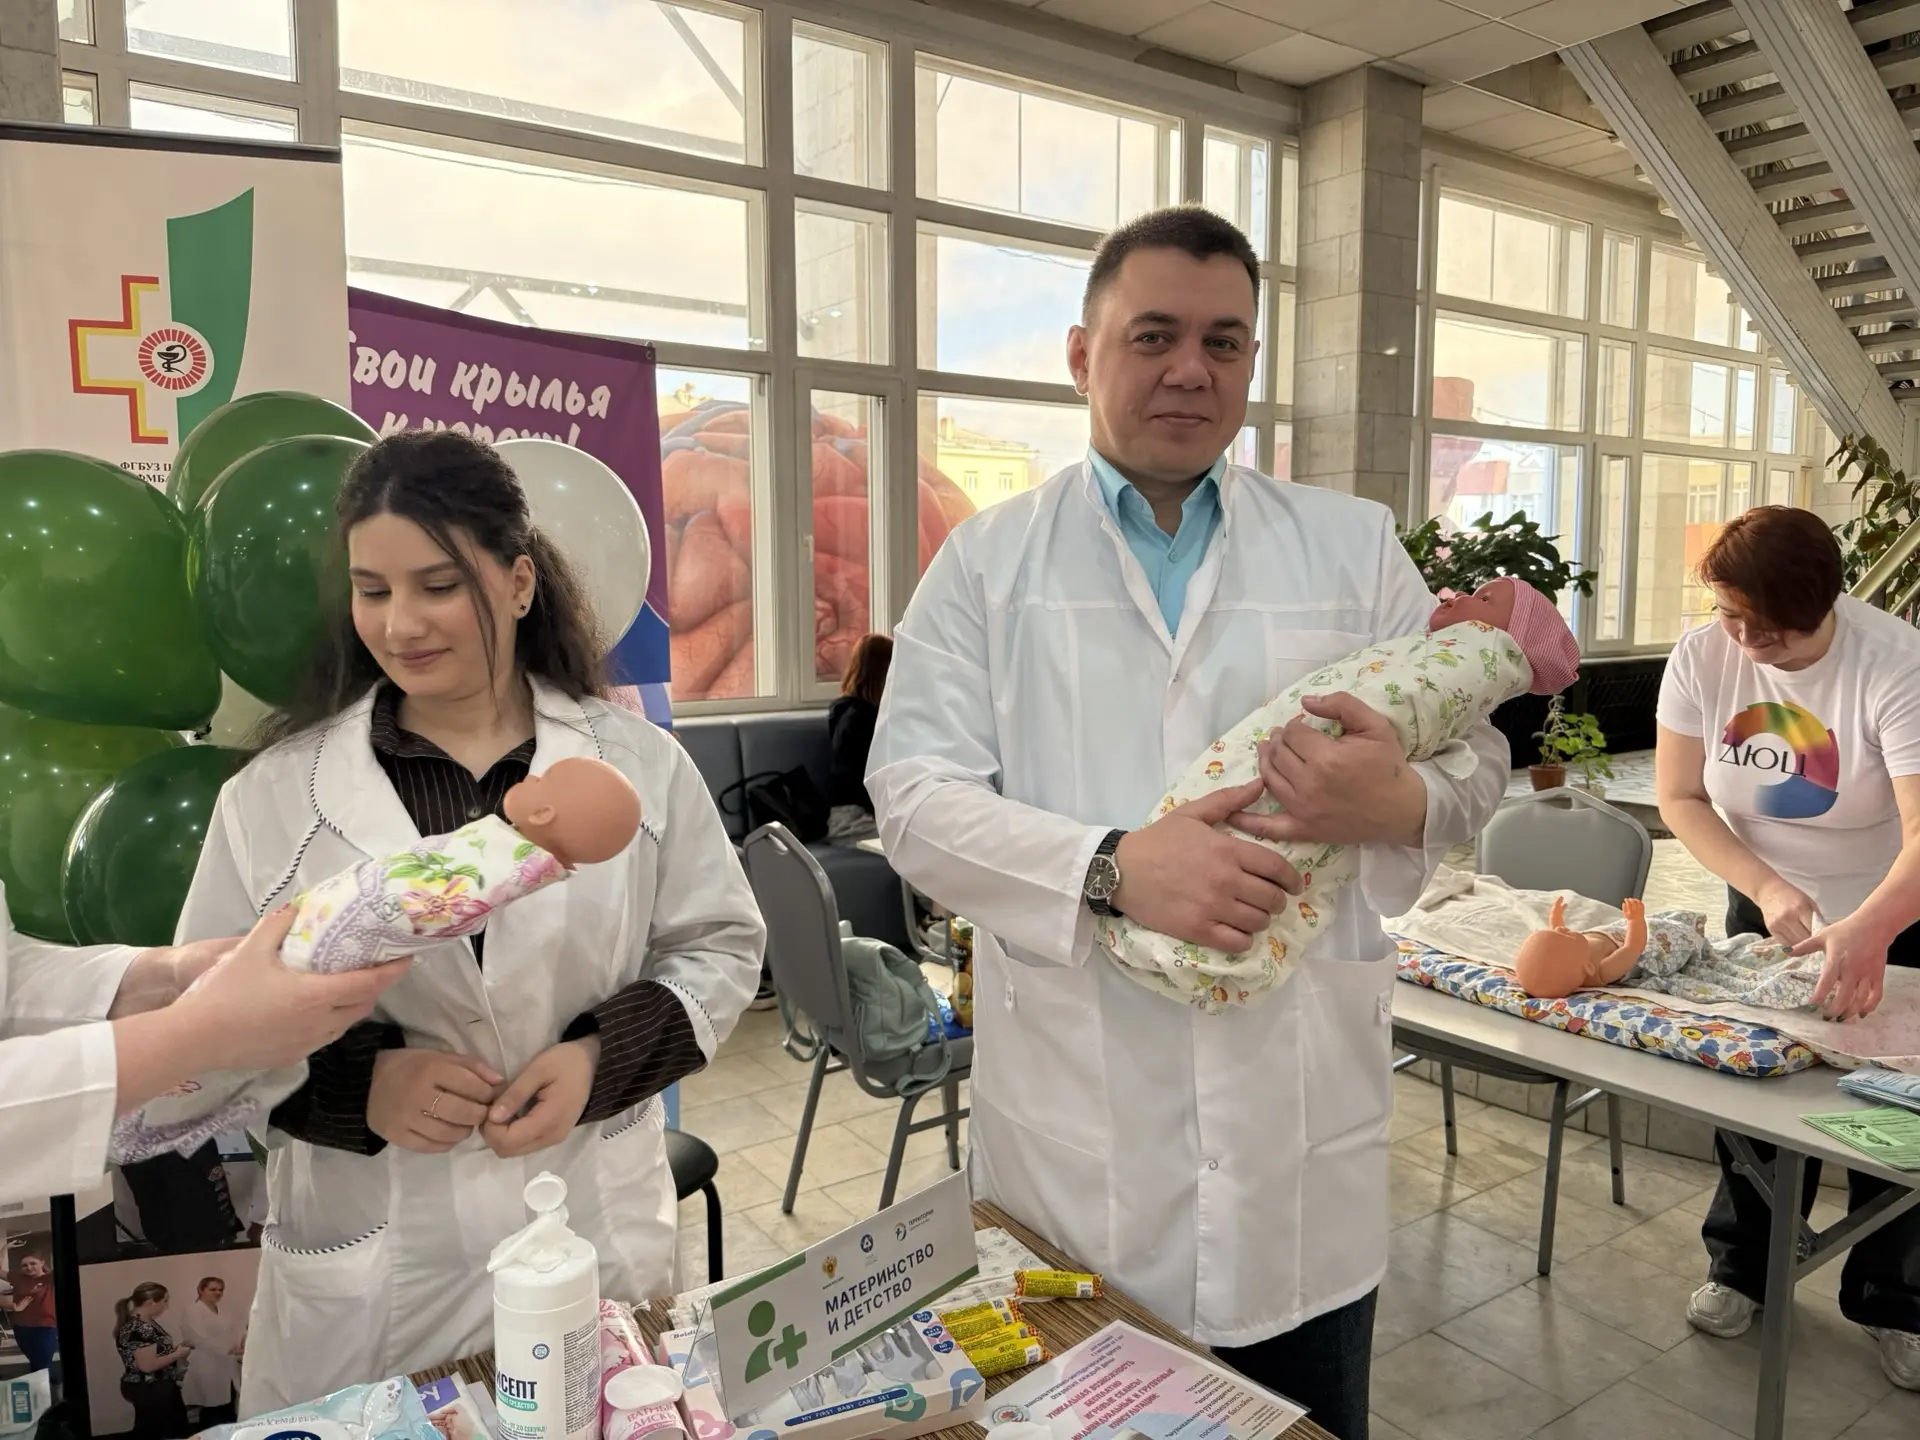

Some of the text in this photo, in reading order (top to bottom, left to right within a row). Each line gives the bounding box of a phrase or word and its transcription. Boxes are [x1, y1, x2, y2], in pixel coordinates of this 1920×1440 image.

[449, 360, 612, 420] крылья
[120, 462, 160, 472] ФГБУЗ
[1718, 741, 1807, 778] ДЮЦ
[825, 1243, 934, 1315] МАТЕРИНСТВО
[827, 1318, 840, 1335] И
[843, 1276, 912, 1330] ДЕТСТВО
[1046, 1388, 1091, 1420] УНИКАЛЬНАЯ
[1089, 1358, 1135, 1391] ВОЗМОЖНОСТЬ
[1083, 1379, 1122, 1407] БЕСПЛАТНО
[1140, 1367, 1176, 1395] ГРУППОВЫЕ
[815, 1409, 834, 1419] FIRST
[837, 1404, 855, 1412] BABY
[857, 1398, 875, 1407] CARE
[878, 1394, 890, 1402] SET
[1083, 1395, 1116, 1420] ИГРОВЫЕ
